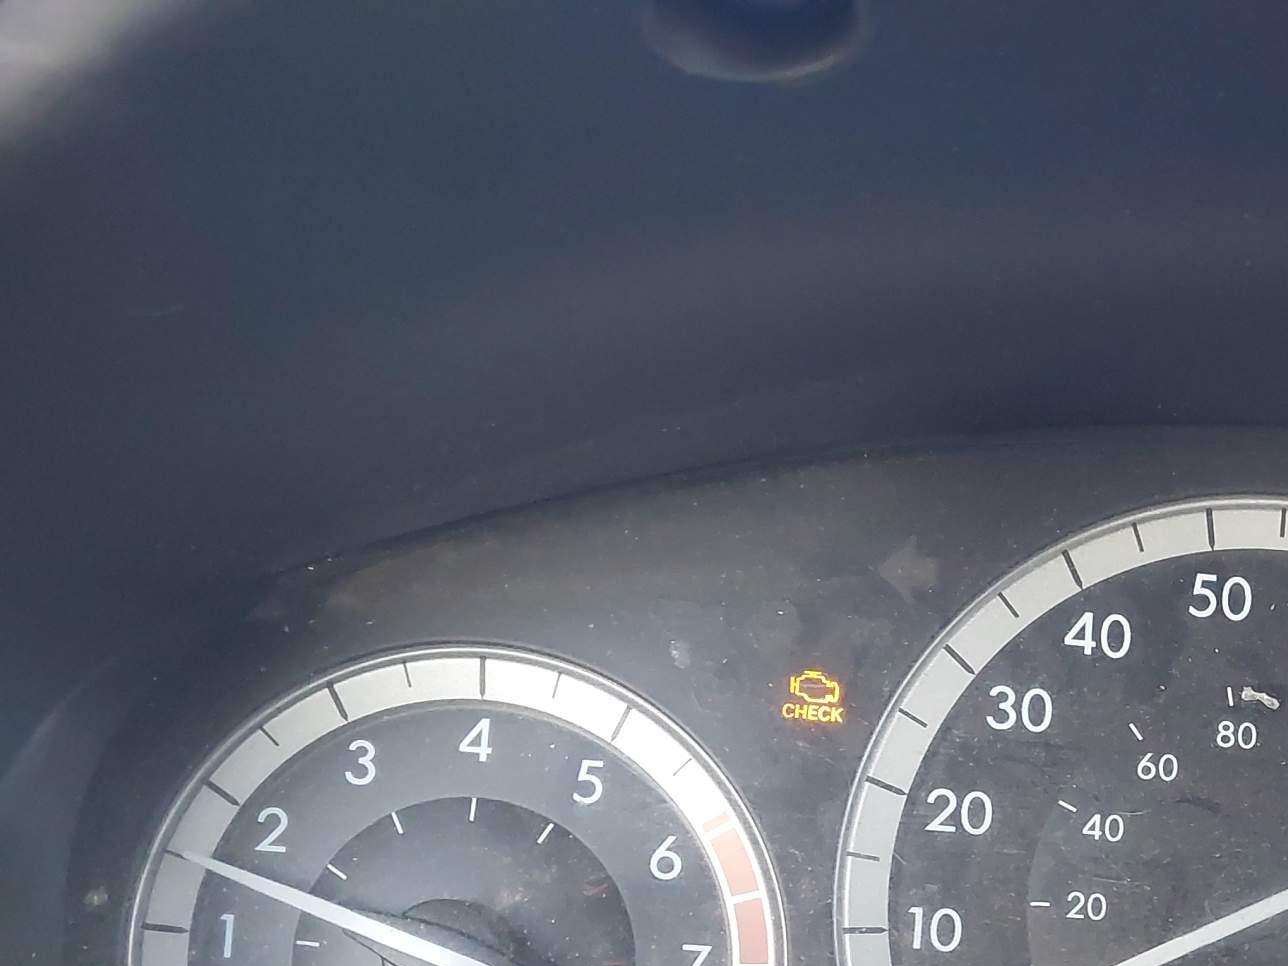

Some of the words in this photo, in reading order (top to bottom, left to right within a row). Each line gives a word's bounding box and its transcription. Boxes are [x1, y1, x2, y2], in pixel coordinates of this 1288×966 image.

[1189, 574, 1251, 621] 50
[1065, 612, 1131, 658] 40
[782, 703, 844, 723] CHECK
[987, 686, 1052, 732] 30
[459, 719, 492, 761] 4
[1217, 721, 1256, 749] 80
[345, 740, 375, 785] 3
[573, 760, 603, 804] 5
[1138, 753, 1177, 781] 60
[255, 808, 288, 852] 2
[925, 789, 992, 834] 20
[1083, 814, 1123, 841] 40
[650, 836, 681, 879] 6
[1066, 892, 1106, 920] 20
[221, 914, 234, 958] 1
[908, 907, 961, 951] 10
